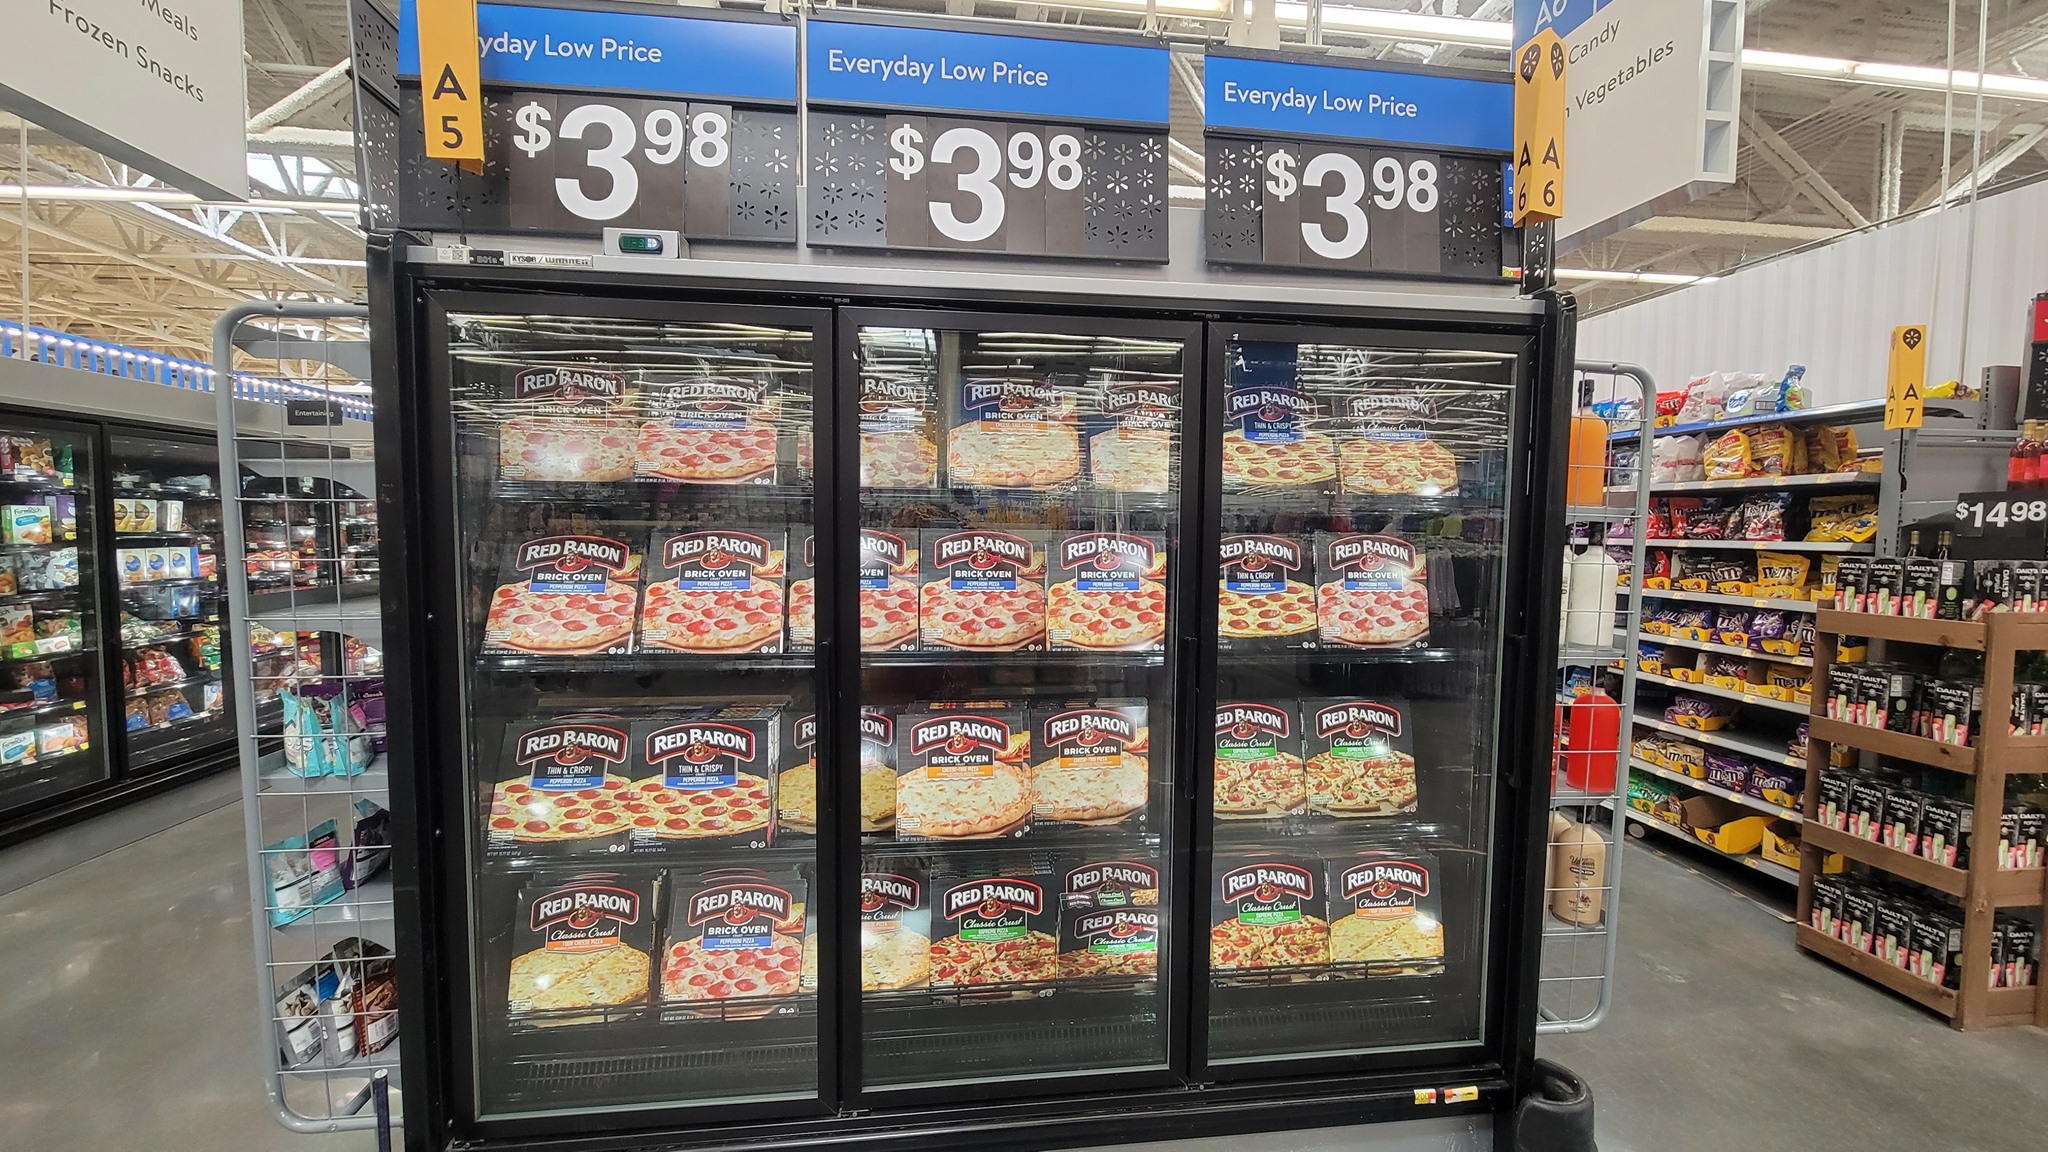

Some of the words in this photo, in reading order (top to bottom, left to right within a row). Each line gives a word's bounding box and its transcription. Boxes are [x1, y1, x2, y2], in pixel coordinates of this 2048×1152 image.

[49, 0, 128, 58] Frozen
[136, 45, 204, 102] Snacks
[478, 32, 537, 61] yday
[544, 34, 593, 59] Low
[601, 38, 662, 63] Price
[1568, 20, 1621, 65] Candy
[828, 49, 933, 84] Everyday
[940, 58, 986, 82] Low
[992, 62, 1049, 87] Price
[1575, 41, 1674, 111] Vegetables
[433, 63, 467, 100] A
[1223, 81, 1317, 114] Everyday
[1322, 89, 1362, 112] Low
[1368, 93, 1418, 118] Price
[442, 116, 463, 149] 5
[1517, 141, 1532, 176] A
[1542, 137, 1560, 170] A
[1518, 182, 1526, 211] 6
[1543, 180, 1556, 207] 6
[524, 374, 556, 392] RED
[560, 371, 617, 395] BARON
[865, 379, 917, 400] BARON
[972, 384, 1000, 400] RED
[1004, 382, 1055, 403] BARON
[1888, 385, 1896, 402] A
[1903, 382, 1918, 400] A
[538, 406, 570, 414] BRICK
[573, 406, 601, 414] OVEN
[1108, 392, 1135, 410] RED
[1233, 394, 1259, 411] RED
[1261, 391, 1309, 412] BARON
[985, 412, 1014, 420] BRICK
[1017, 412, 1043, 421] OVEN
[1888, 408, 1894, 425] 7
[1905, 408, 1915, 423] 7
[526, 543, 561, 562] RED
[563, 540, 620, 563] BARON
[671, 540, 704, 559] RED
[706, 536, 762, 560] BARON
[942, 540, 972, 558] RED
[974, 536, 1025, 559] BARON
[1068, 540, 1096, 560] RED
[1098, 537, 1148, 559] BARON
[1220, 543, 1242, 558] RED
[1245, 540, 1293, 561] BARON
[1335, 542, 1361, 561] RED
[1363, 540, 1408, 561] BARON
[537, 573, 570, 581] BRICK
[572, 573, 602, 581] OVEN
[685, 570, 716, 578] BRICK
[718, 570, 746, 578] OVEN
[1237, 572, 1248, 580] THIN
[1255, 572, 1274, 580] CRISPY
[1051, 718, 1079, 738] RED
[1081, 715, 1130, 736] BARON
[1216, 712, 1234, 727] ED
[1234, 709, 1281, 729] BARON
[1322, 711, 1348, 730] RED
[1349, 708, 1394, 728] BARON
[525, 734, 560, 756] RED
[563, 730, 619, 753] BARON
[654, 733, 688, 754] RED
[689, 728, 747, 752] BARON
[918, 725, 948, 746] RED
[950, 721, 1002, 742] BARON
[1220, 739, 1248, 748] Classic
[1250, 738, 1272, 747] Crust
[1334, 738, 1362, 747] Classic
[932, 756, 960, 764] BRICK
[1064, 747, 1090, 755] BRICK
[1093, 746, 1117, 754] OVEN
[547, 766, 561, 775] THIN
[570, 766, 593, 774] CRISPY
[678, 764, 693, 773] THIN
[694, 765, 699, 773] &
[700, 764, 724, 773] CRISPY
[1072, 870, 1100, 891] RED
[1102, 867, 1151, 887] BARON
[1228, 872, 1256, 893] RED
[1257, 869, 1306, 891] BARON
[1347, 871, 1373, 890] RED
[1375, 866, 1422, 887] BARON
[862, 878, 912, 900] BARON
[950, 888, 980, 911] RED
[983, 884, 1035, 906] BARON
[539, 897, 572, 920] RED
[574, 892, 630, 914] BARON
[696, 893, 729, 916] RED
[731, 890, 784, 912] BARON
[1242, 902, 1272, 912] Classic
[1273, 901, 1296, 911] Crust
[1359, 898, 1387, 908] Classic
[1389, 897, 1411, 906] Crust
[874, 910, 900, 920] Crust
[963, 918, 996, 929] Classic
[997, 916, 1024, 926] Crust
[1082, 915, 1113, 931] RED
[551, 930, 586, 941] Classic
[588, 926, 616, 937] Crust
[708, 927, 737, 935] BRICK
[740, 925, 768, 933] OVEN
[1094, 938, 1126, 946] Classic
